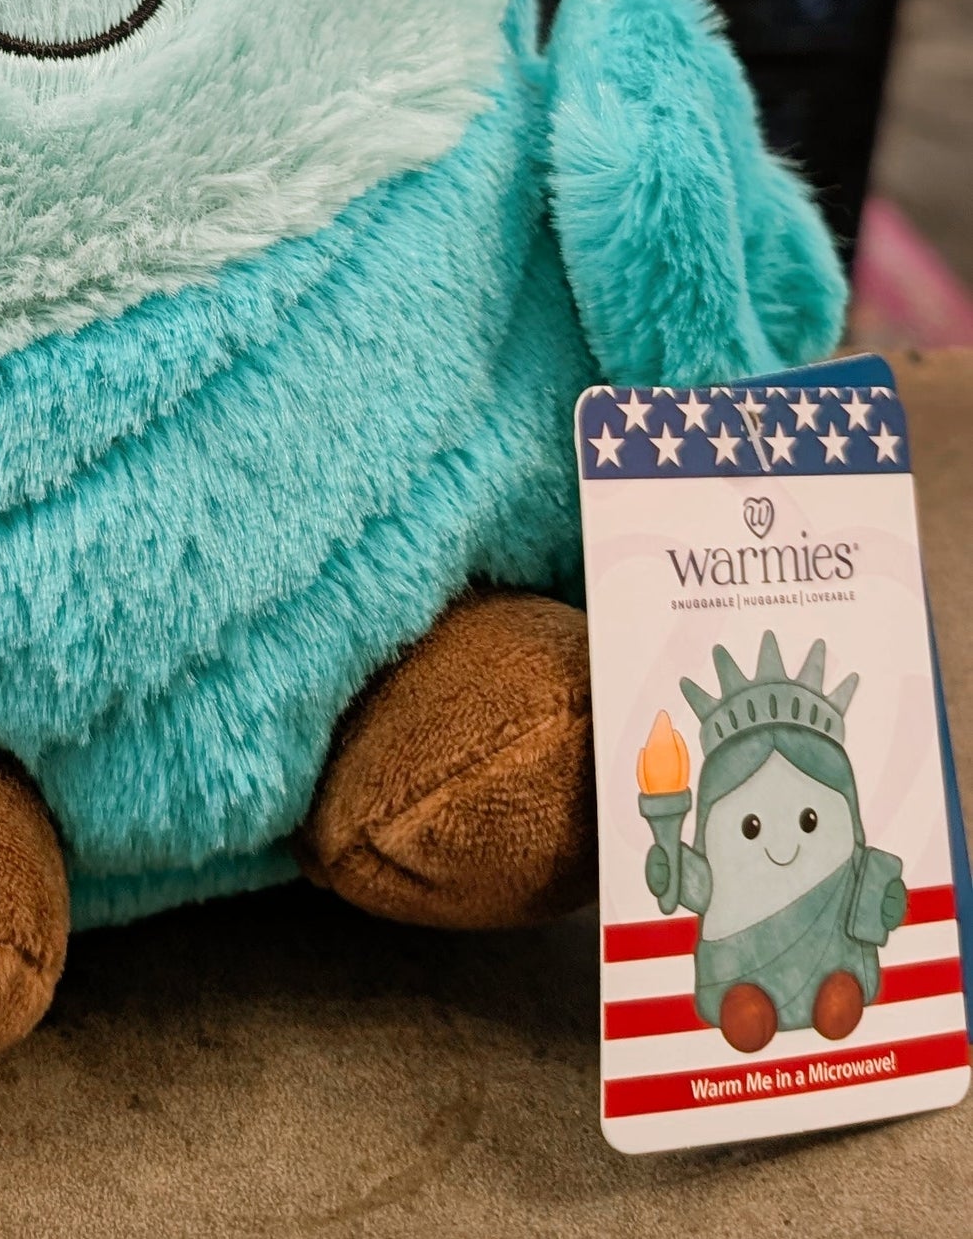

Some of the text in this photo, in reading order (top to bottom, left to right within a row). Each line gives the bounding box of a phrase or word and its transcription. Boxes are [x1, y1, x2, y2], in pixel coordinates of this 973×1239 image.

[671, 590, 856, 610] SNUGGABLE HUGGABLE LOVEABLE
[690, 1050, 896, 1100] Warm Me in a Microwave!
